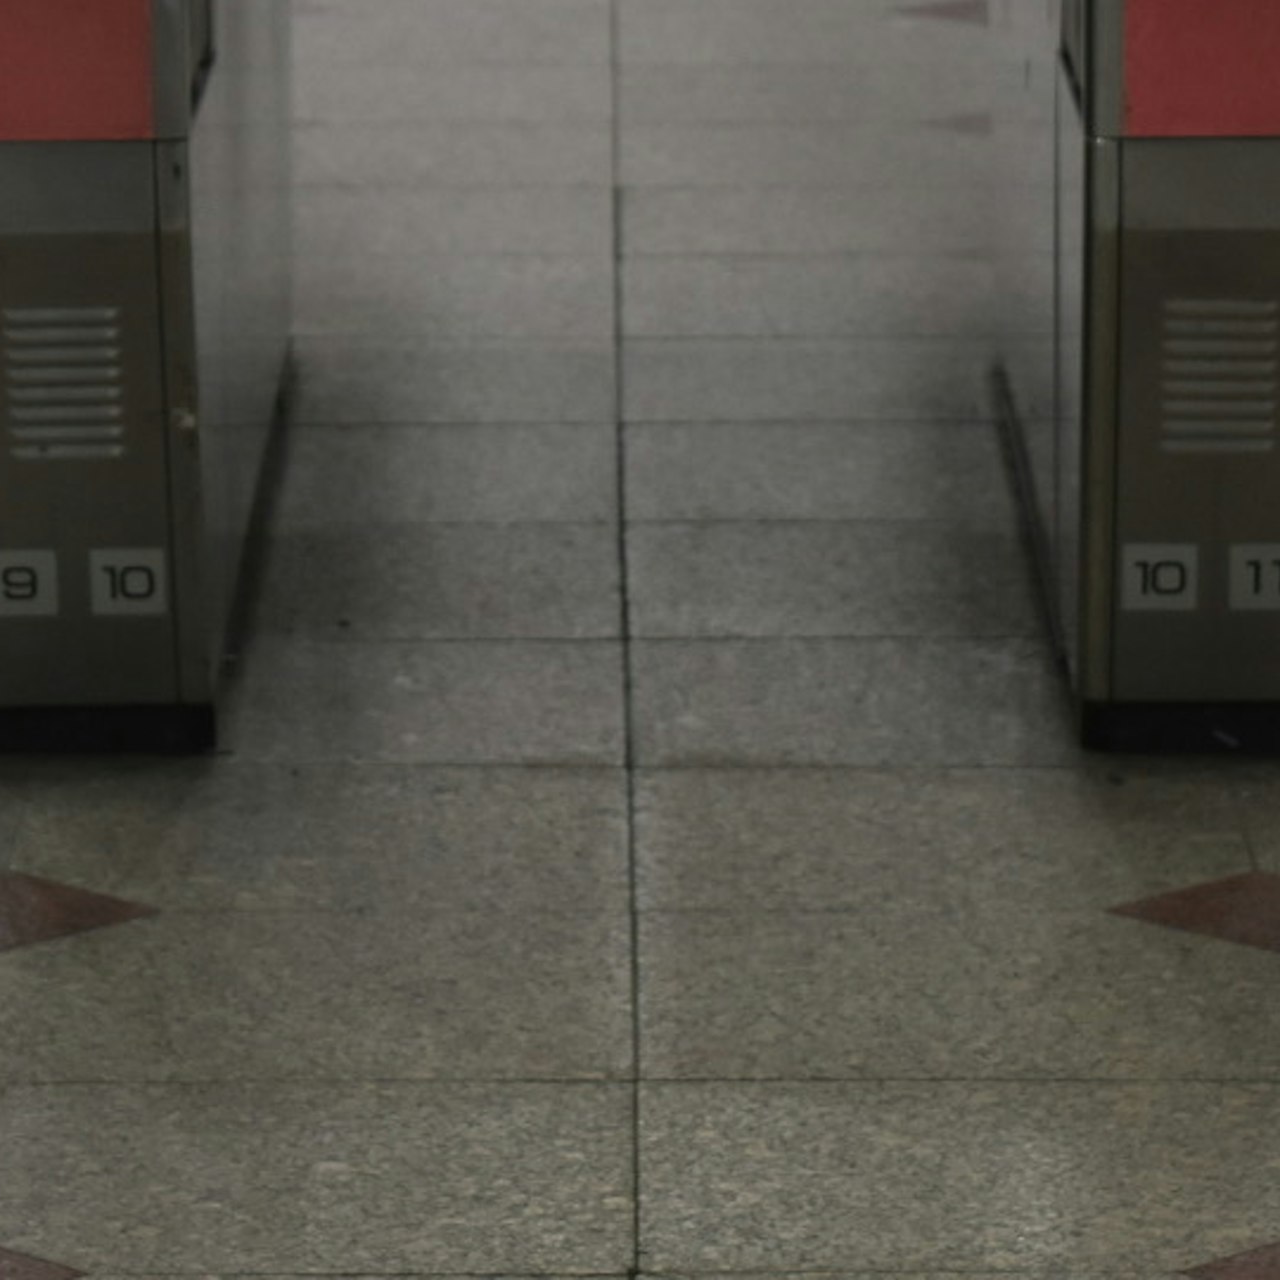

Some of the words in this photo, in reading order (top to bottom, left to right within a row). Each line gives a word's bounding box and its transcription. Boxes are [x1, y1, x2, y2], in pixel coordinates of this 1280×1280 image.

[1, 565, 38, 601] 9
[102, 564, 156, 601] 10
[1134, 559, 1187, 596] 10
